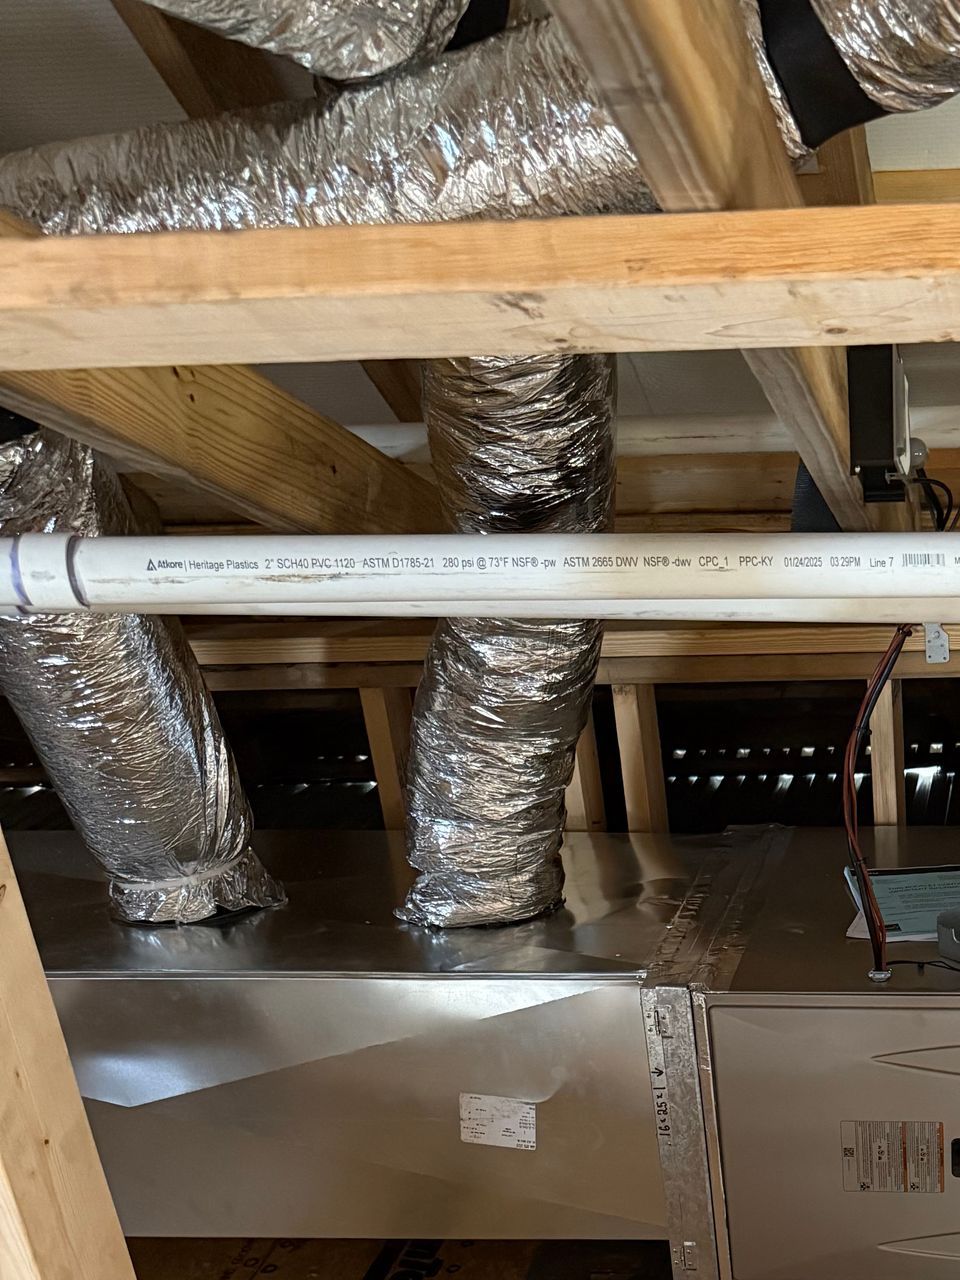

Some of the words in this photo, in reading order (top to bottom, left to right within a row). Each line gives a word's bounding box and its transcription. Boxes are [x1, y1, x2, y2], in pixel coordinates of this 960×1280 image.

[157, 560, 183, 570] Atkore
[188, 560, 225, 572] Heritage
[226, 560, 259, 571] Plastics
[276, 558, 309, 569] SCH40
[311, 558, 332, 569] PVC
[334, 558, 356, 569] 1120
[362, 558, 390, 569] ASTM
[392, 557, 435, 569] D1785-21
[443, 557, 459, 569] 280
[461, 558, 475, 570] psi
[477, 558, 487, 570] @
[488, 557, 509, 568] 73°F
[563, 557, 590, 568] ASTM
[592, 557, 614, 568] 2665
[615, 557, 639, 568] DWV
[739, 556, 774, 568] PPC-KY
[783, 556, 823, 568] 01/24/2025
[869, 557, 887, 569] Line
[888, 556, 895, 568] 7
